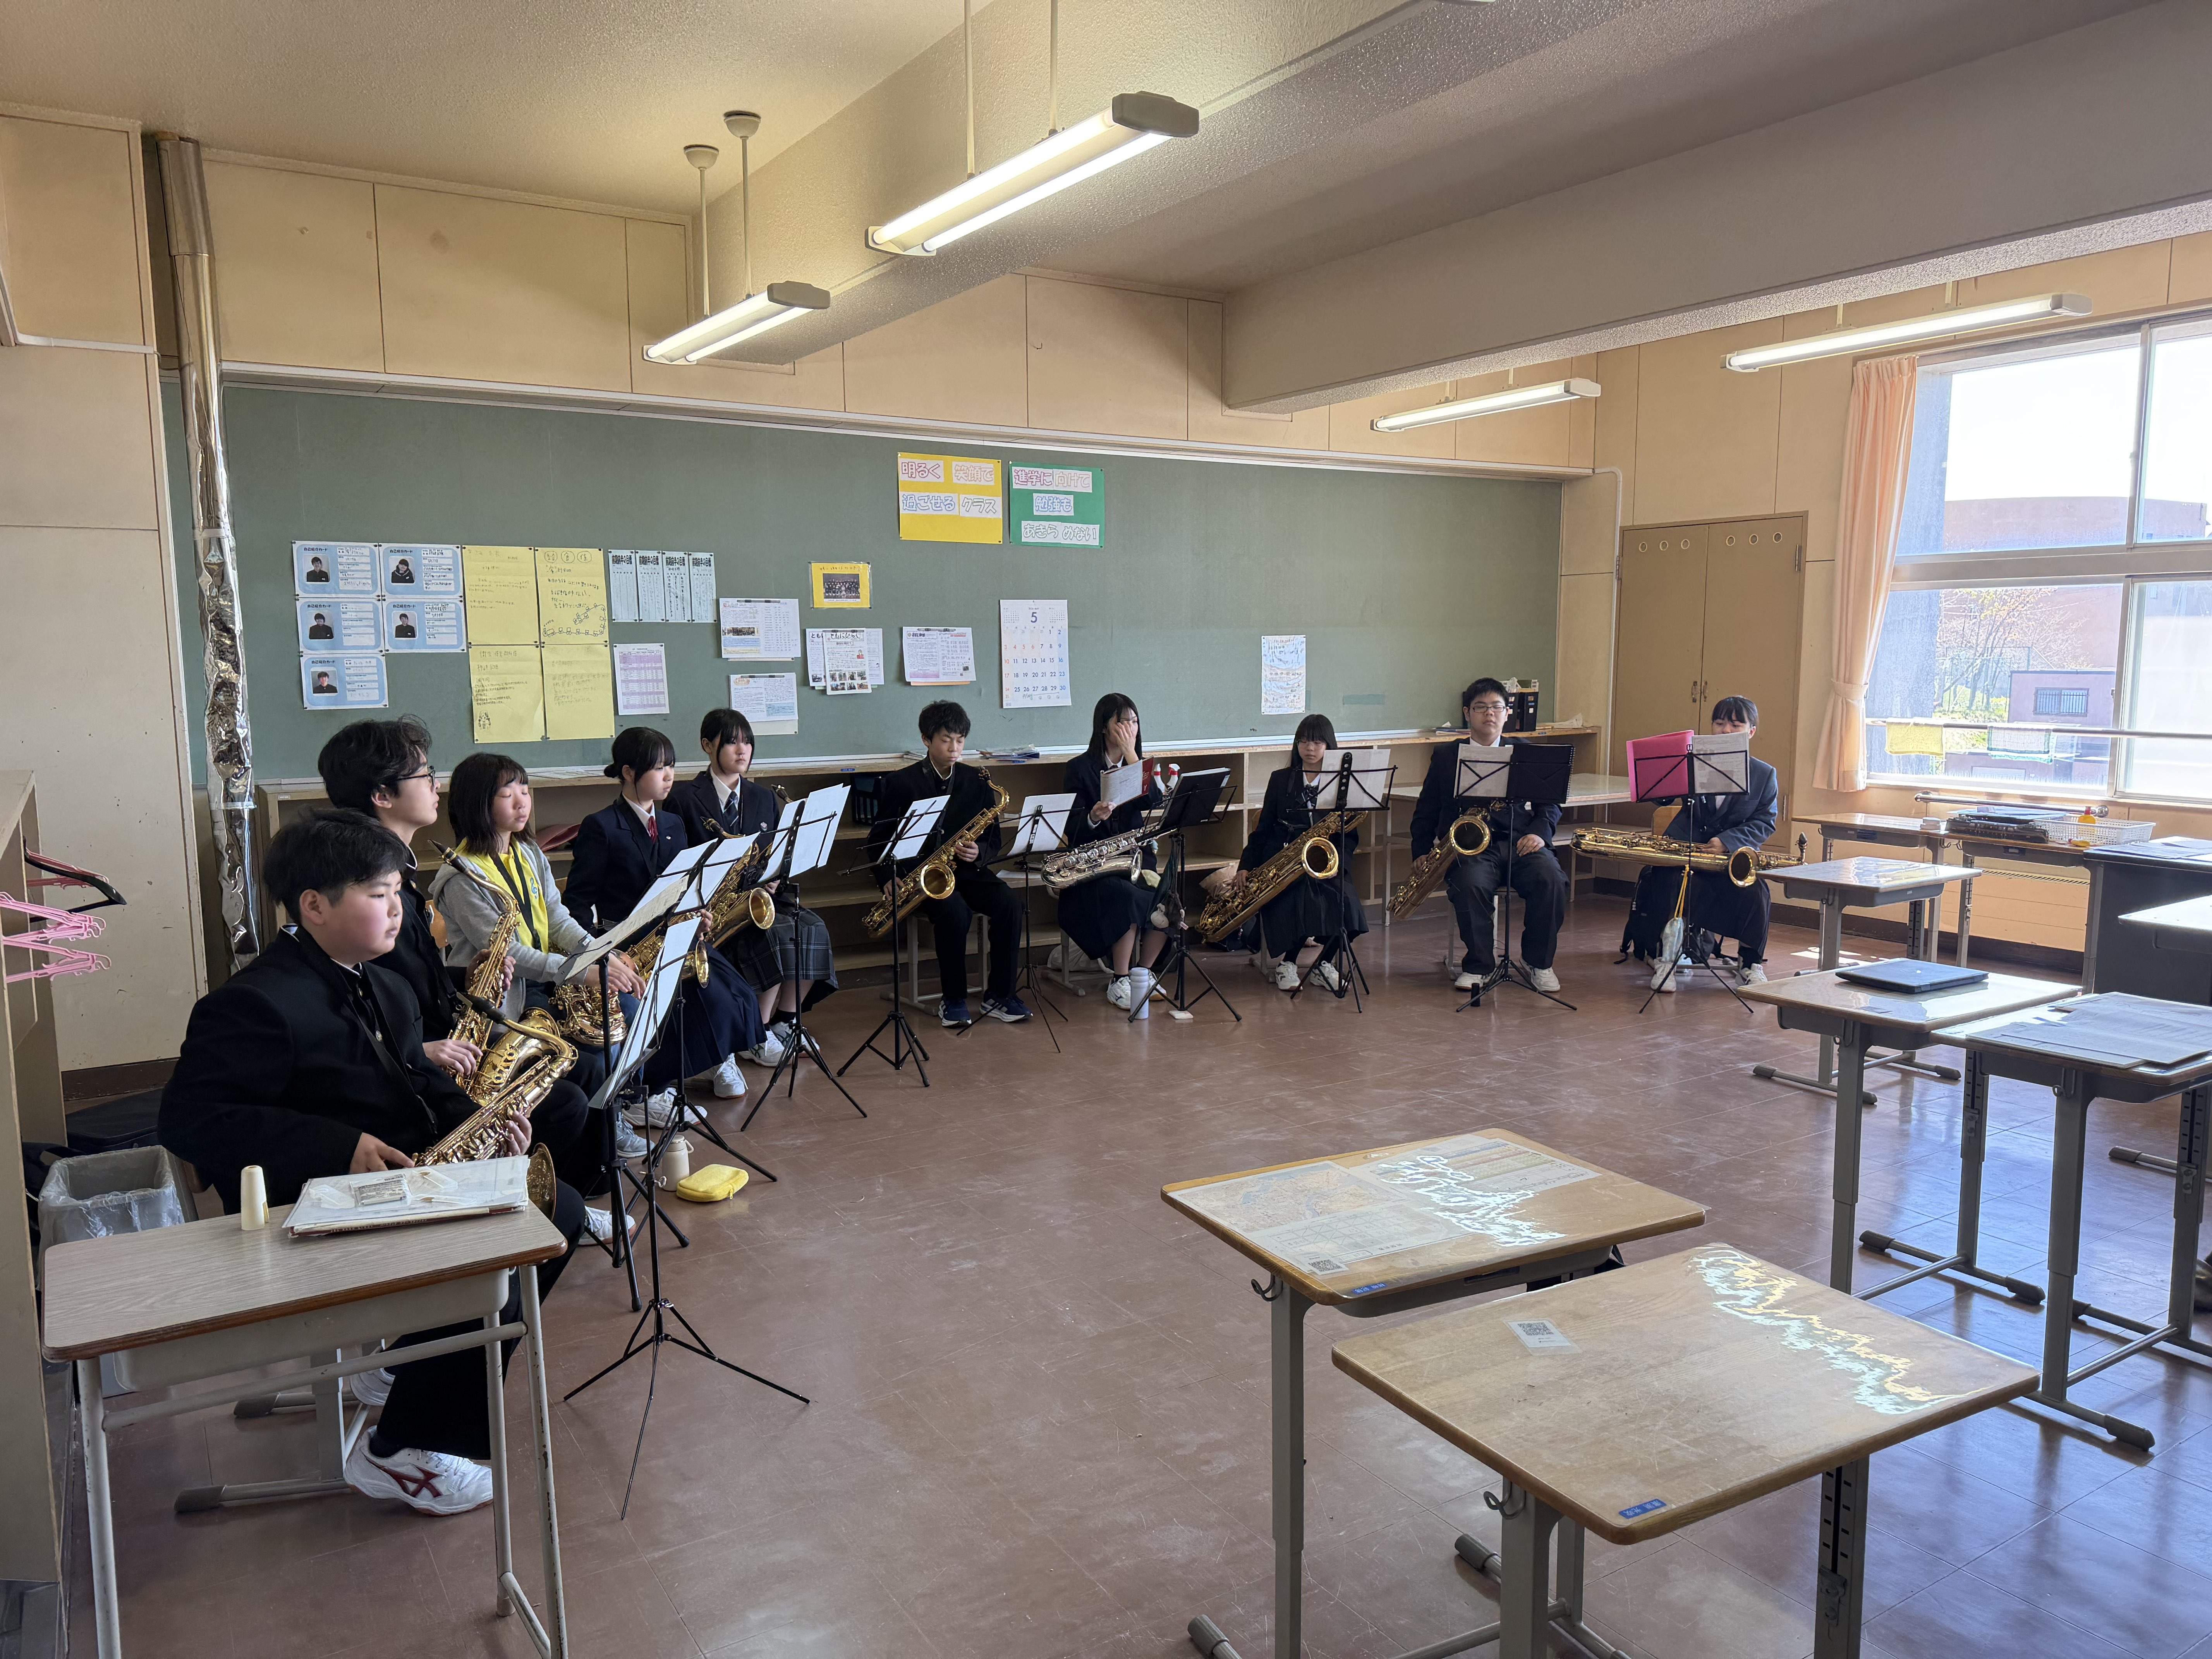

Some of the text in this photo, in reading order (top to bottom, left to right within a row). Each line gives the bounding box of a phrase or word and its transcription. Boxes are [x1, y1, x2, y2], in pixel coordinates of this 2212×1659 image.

[902, 462, 993, 481] 明るく 笑顔で
[902, 494, 996, 513] 過ごせる クラス
[1036, 496, 1072, 512] 勉強も
[1031, 612, 1037, 623] 5
